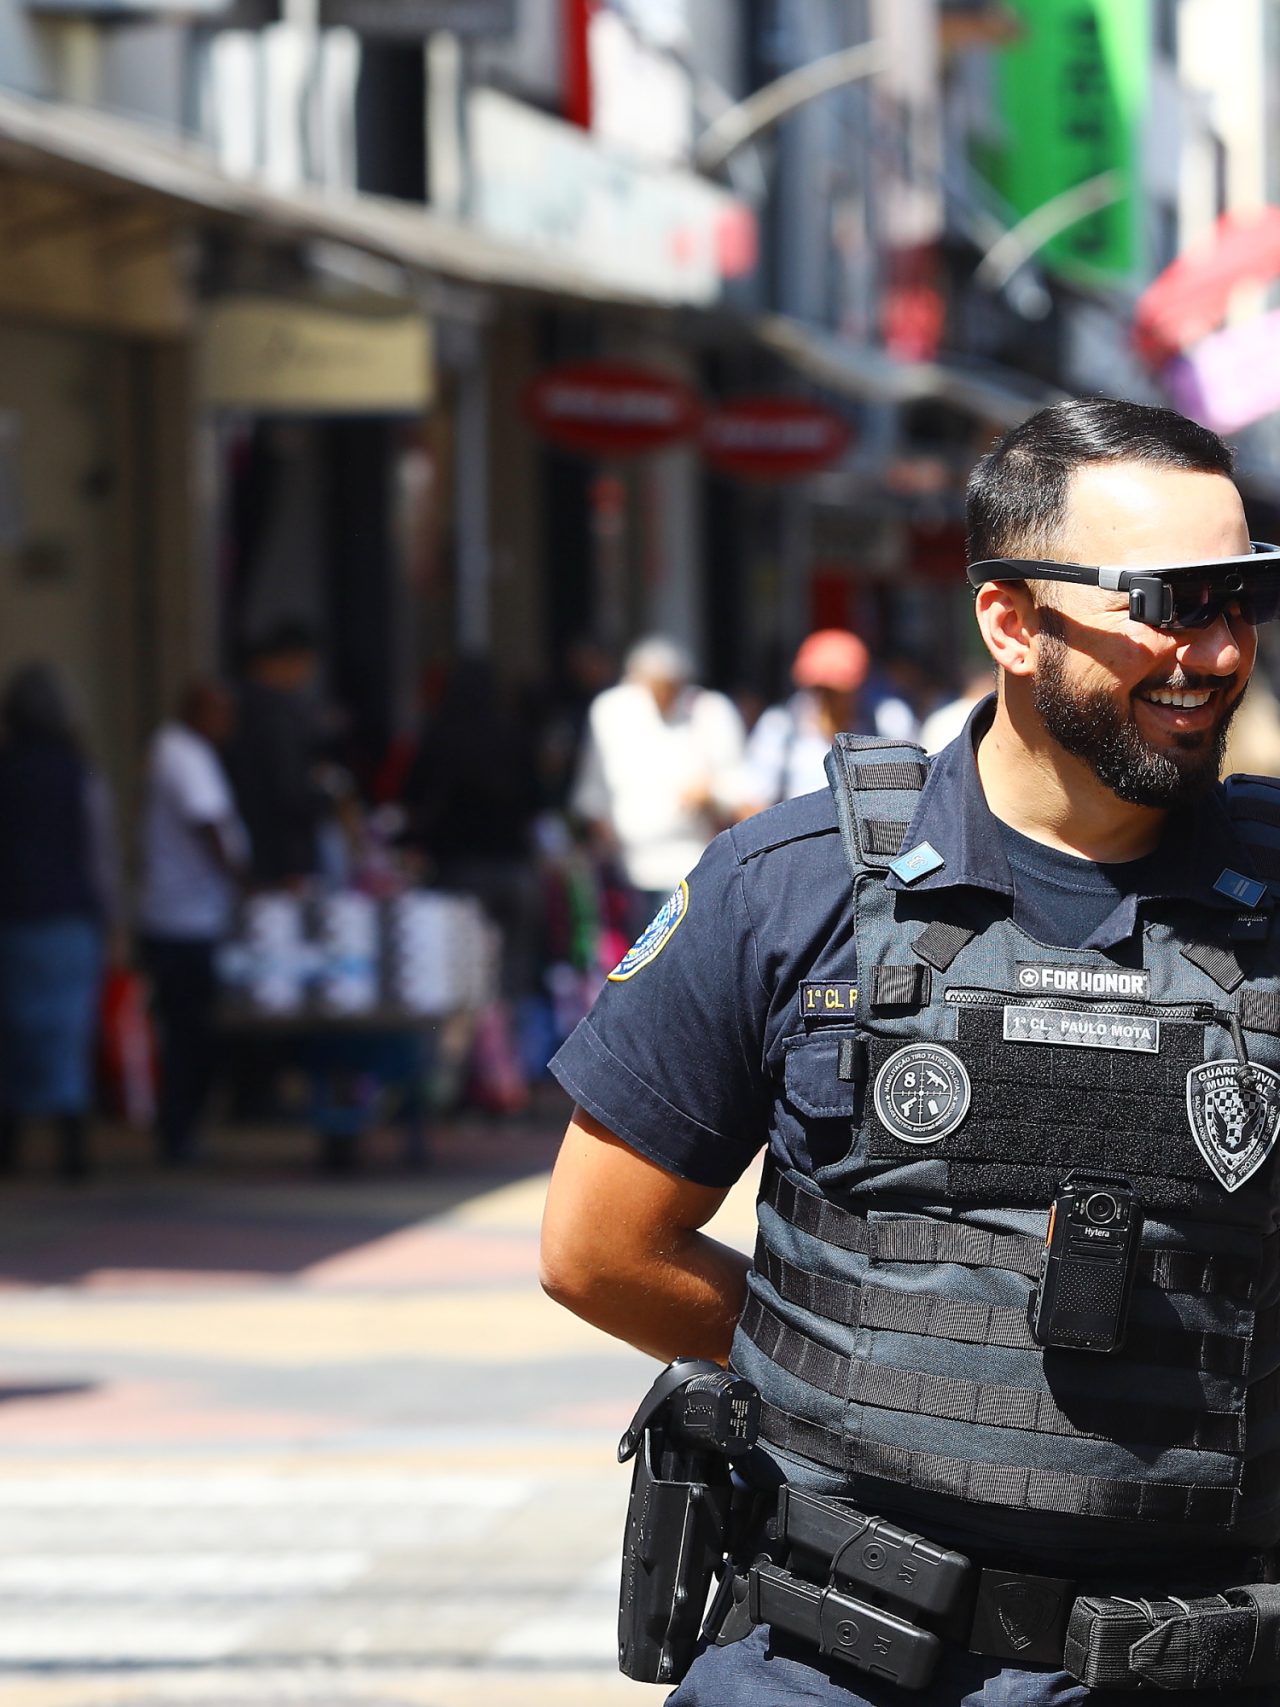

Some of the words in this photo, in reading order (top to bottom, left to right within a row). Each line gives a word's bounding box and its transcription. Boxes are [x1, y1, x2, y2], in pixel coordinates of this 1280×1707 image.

[825, 988, 845, 1008] CL
[1060, 1020, 1107, 1036] PAULO
[1111, 1024, 1152, 1040] MOTA
[884, 1056, 911, 1093] HABILITAÇÃO
[911, 1053, 926, 1061] TIRO
[927, 1052, 948, 1068] TÁTICO
[947, 1065, 961, 1093] POLICIAL
[904, 1071, 916, 1088] 8
[1198, 1066, 1239, 1081] GUARD
[1237, 1140, 1266, 1177] PROTEGER
[1264, 1104, 1278, 1135] SERVIR
[1084, 1227, 1110, 1238] Hytera
